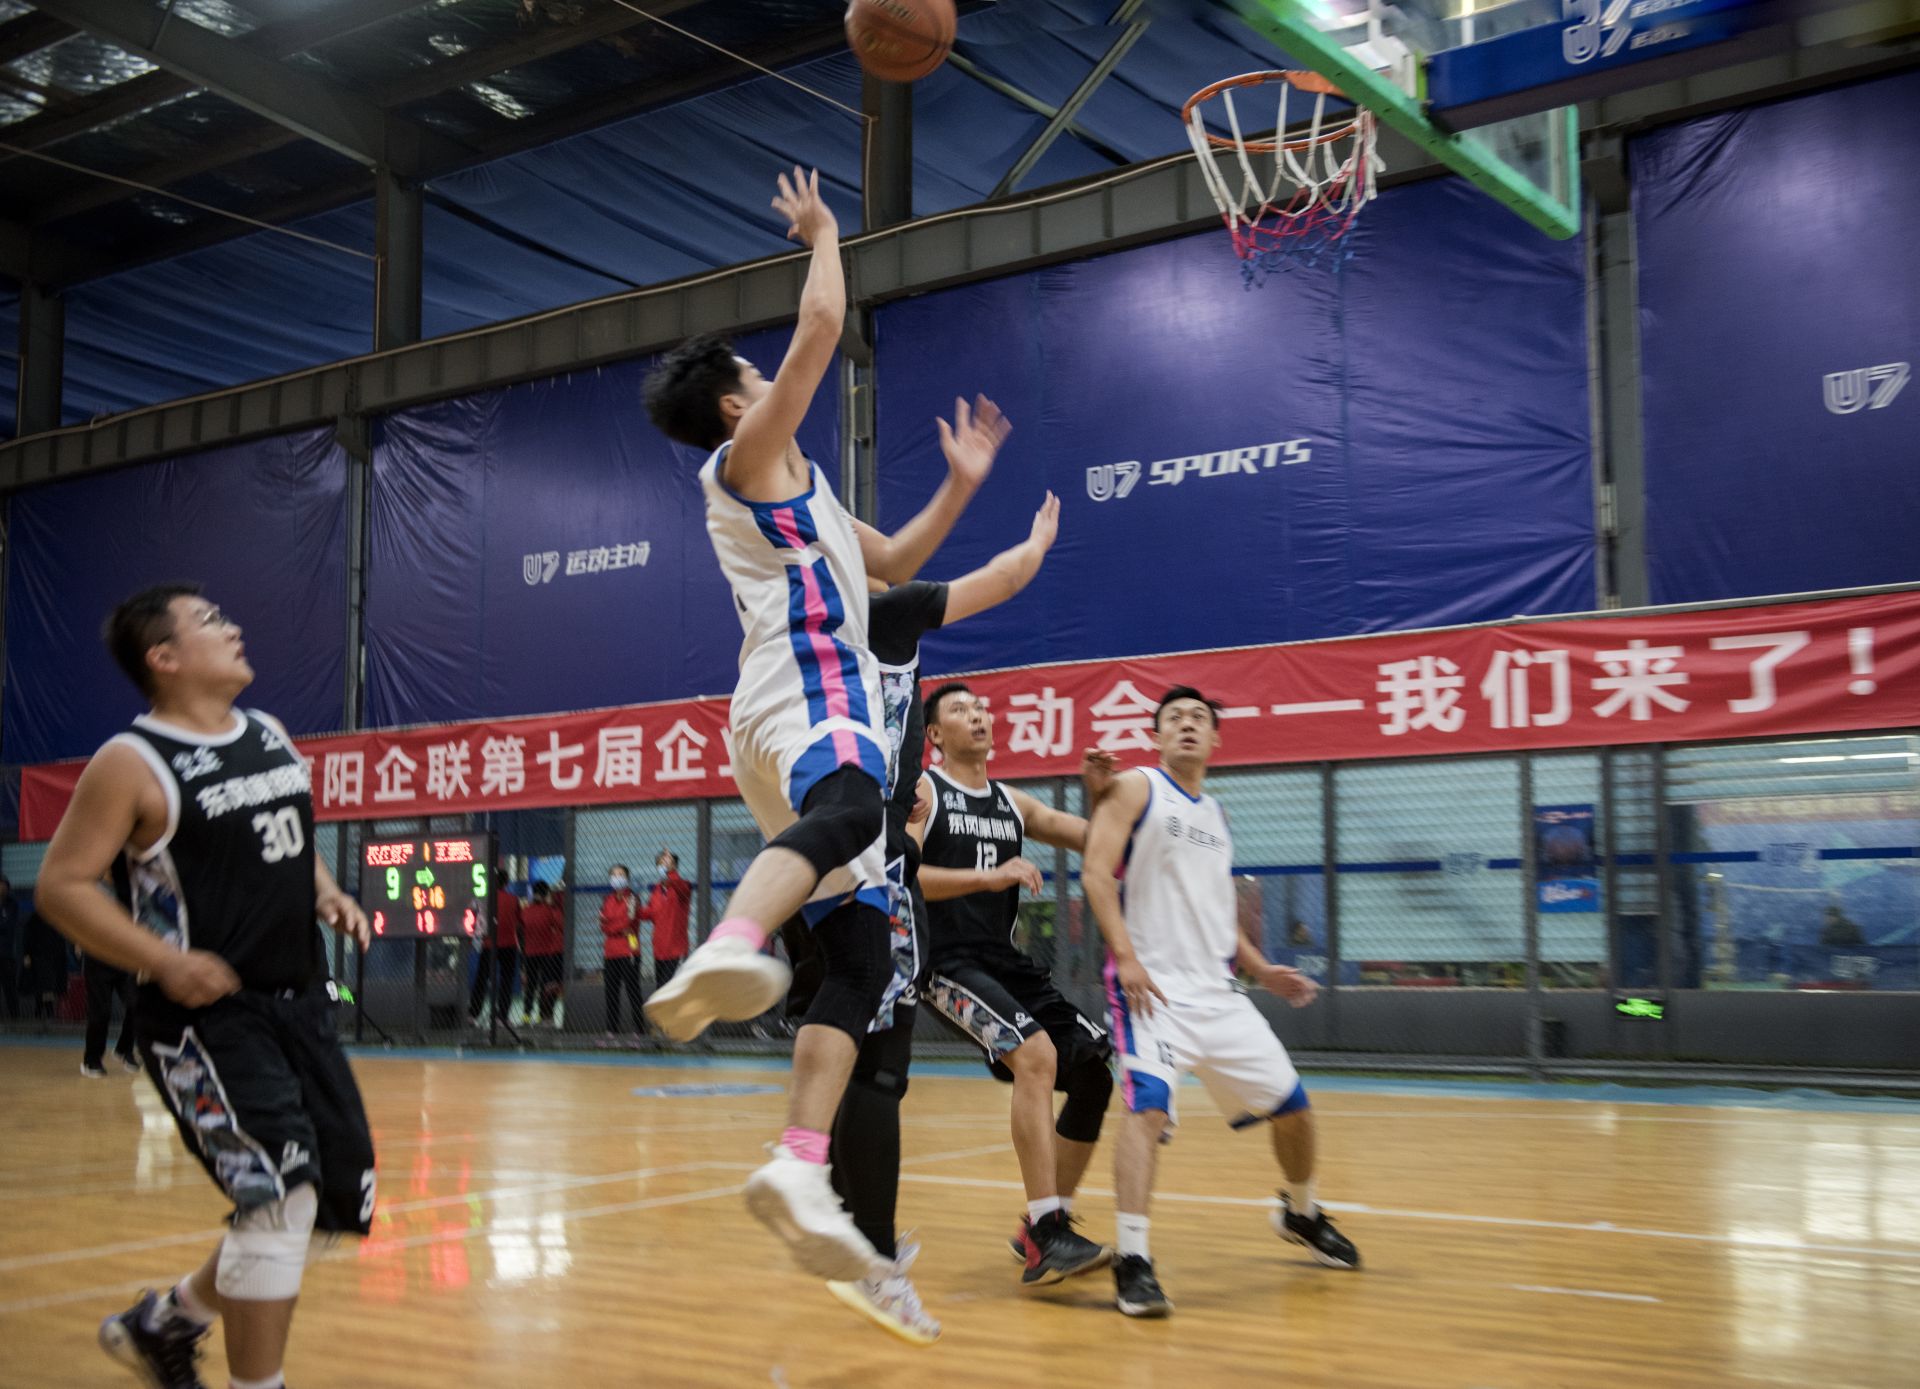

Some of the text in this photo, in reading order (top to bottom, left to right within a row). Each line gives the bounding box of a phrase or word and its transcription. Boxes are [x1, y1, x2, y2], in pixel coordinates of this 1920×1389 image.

[1823, 361, 1911, 415] U7
[1086, 438, 1312, 502] U7 SPORTS
[523, 540, 651, 585] U7 运动主场
[306, 718, 736, 808] 阳企联第七届企
[252, 805, 305, 863] 30
[974, 841, 998, 872] 12
[386, 863, 486, 900] 9 5
